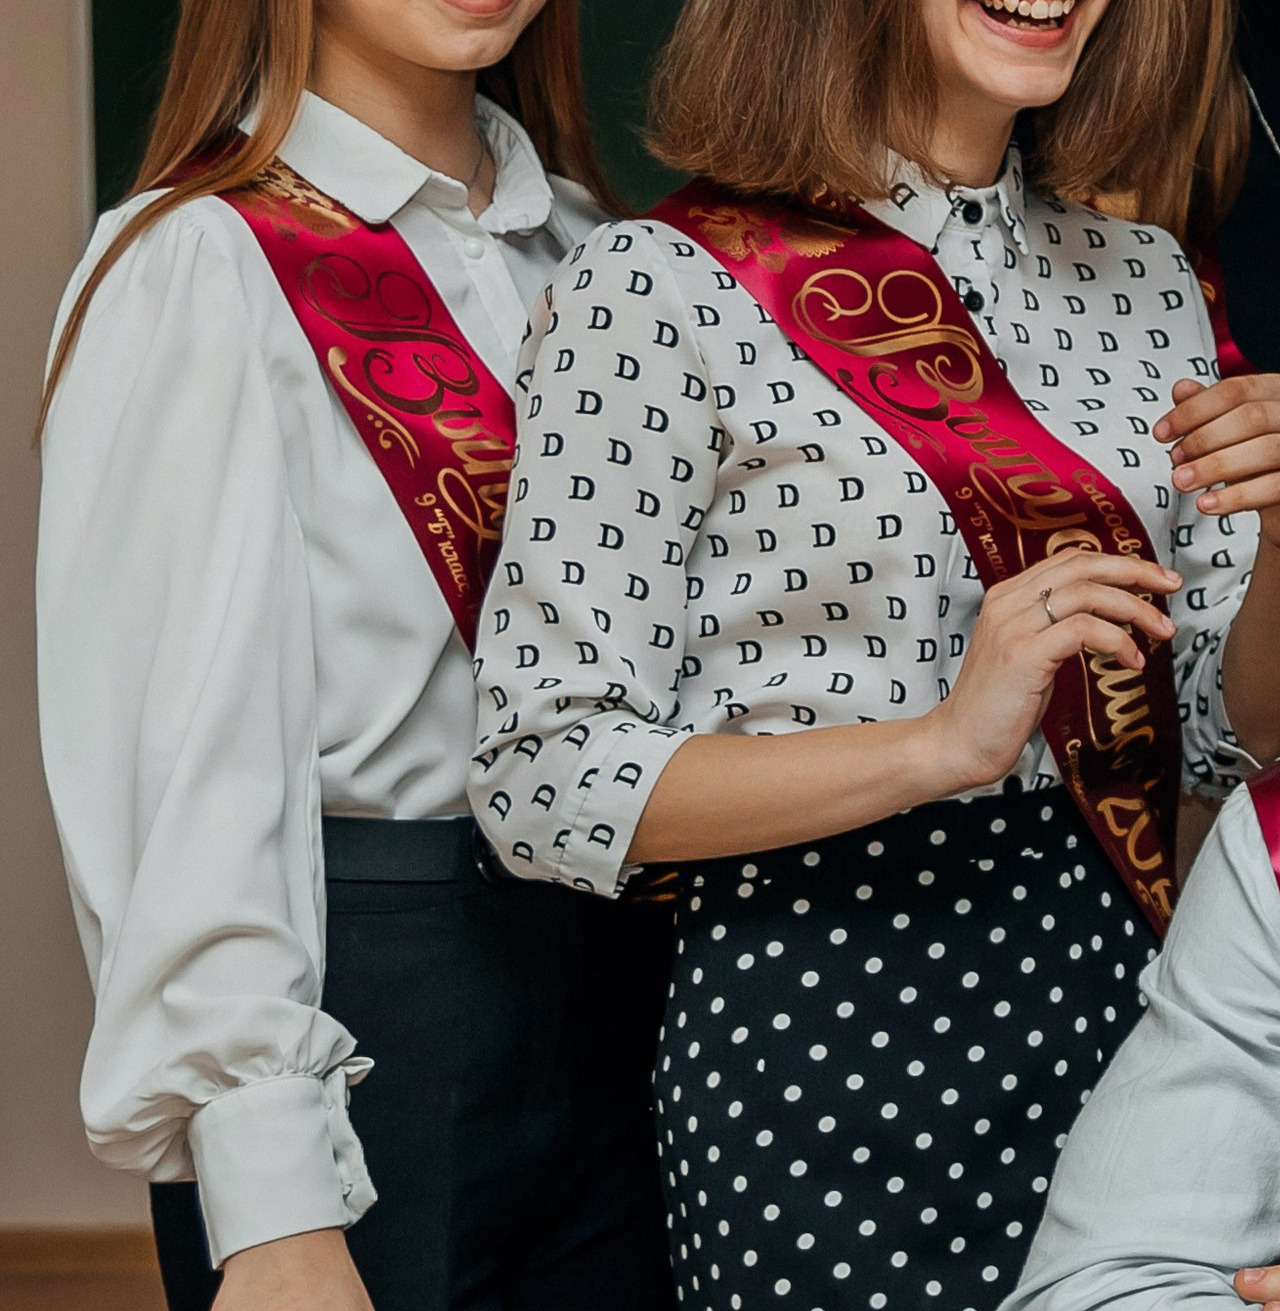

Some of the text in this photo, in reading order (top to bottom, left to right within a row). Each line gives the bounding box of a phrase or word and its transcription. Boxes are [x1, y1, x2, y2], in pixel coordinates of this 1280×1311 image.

[608, 235, 632, 252] D
[1083, 228, 1106, 248] D
[669, 243, 695, 257] D
[1036, 255, 1051, 278] D
[1072, 263, 1096, 281] D
[1123, 259, 1145, 278] D
[573, 269, 592, 290] D
[626, 270, 653, 296] D
[1022, 289, 1039, 311] D
[1063, 296, 1085, 314] D
[1112, 294, 1131, 315] D
[1159, 290, 1183, 311] D
[588, 306, 612, 329] D
[693, 305, 720, 327] D
[653, 320, 679, 348] D
[1011, 323, 1030, 344] D
[1054, 329, 1072, 351] D
[1098, 332, 1118, 352] D
[1146, 329, 1169, 348] D
[554, 349, 574, 372] D
[736, 342, 756, 365] D
[615, 353, 640, 380] D
[1040, 364, 1059, 386] D
[1086, 369, 1111, 385] D
[1139, 360, 1161, 379] D
[1188, 357, 1209, 376] D
[681, 373, 706, 401] D
[713, 385, 735, 410] D
[767, 382, 794, 404] D
[575, 390, 602, 415] D
[642, 405, 668, 432] D
[1126, 417, 1149, 435] D
[750, 421, 777, 444] D
[541, 433, 563, 456] D
[607, 438, 631, 465] D
[797, 444, 824, 463] D
[860, 437, 887, 455] D
[670, 456, 693, 482] D
[1117, 448, 1140, 467] D
[568, 476, 594, 500] D
[777, 484, 799, 508] D
[839, 477, 864, 502] D
[1154, 485, 1169, 509] D
[414, 493, 436, 509] 9
[636, 490, 660, 517] D
[729, 490, 745, 514] D
[530, 518, 556, 541] D
[598, 523, 623, 550] D
[812, 524, 835, 547] D
[877, 515, 902, 539] D
[706, 535, 728, 557] D
[755, 529, 776, 552] D
[662, 541, 683, 566] D
[1211, 550, 1235, 568] D
[505, 562, 523, 586] D
[562, 561, 584, 585] D
[847, 562, 873, 584] D
[914, 554, 935, 577] D
[625, 573, 649, 601] D
[784, 569, 807, 592] D
[886, 596, 906, 620] D
[1186, 588, 1208, 610] D
[494, 609, 509, 634] D
[537, 602, 559, 624] D
[822, 602, 848, 621] D
[649, 624, 674, 649] D
[699, 615, 719, 638] D
[516, 645, 539, 668] D
[575, 642, 598, 664] D
[736, 640, 762, 664] D
[801, 635, 826, 656] D
[864, 635, 886, 658] D
[916, 639, 937, 662] D
[949, 633, 964, 657] D
[827, 673, 853, 694] D
[889, 680, 906, 704] D
[489, 686, 507, 711] D
[790, 705, 816, 726] D
[562, 724, 590, 750] D
[613, 763, 642, 789] D
[489, 791, 511, 821] D
[531, 784, 555, 811] D
[588, 824, 615, 849] D
[512, 841, 533, 863] D
